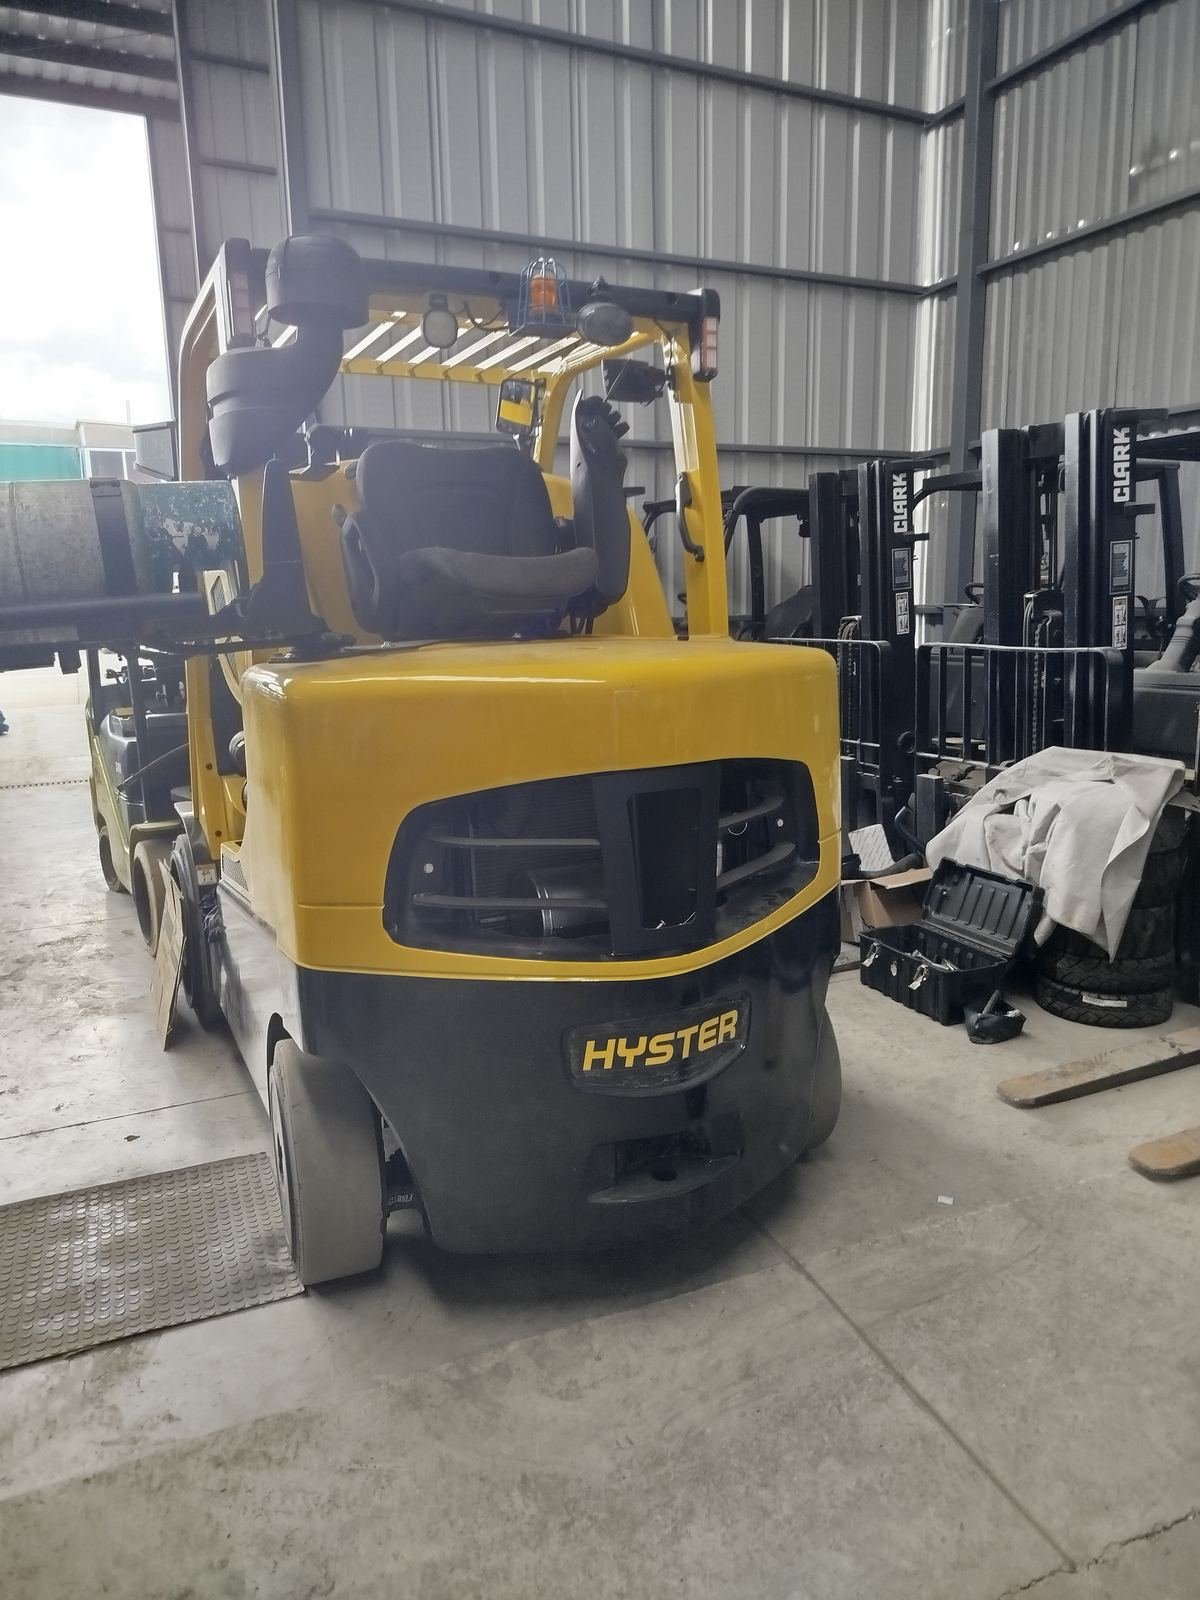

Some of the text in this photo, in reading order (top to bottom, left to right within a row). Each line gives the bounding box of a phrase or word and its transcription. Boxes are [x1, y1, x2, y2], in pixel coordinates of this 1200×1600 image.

[1113, 427, 1130, 503] CLARK
[893, 472, 908, 534] CLARK
[582, 1009, 738, 1071] HYSTER
